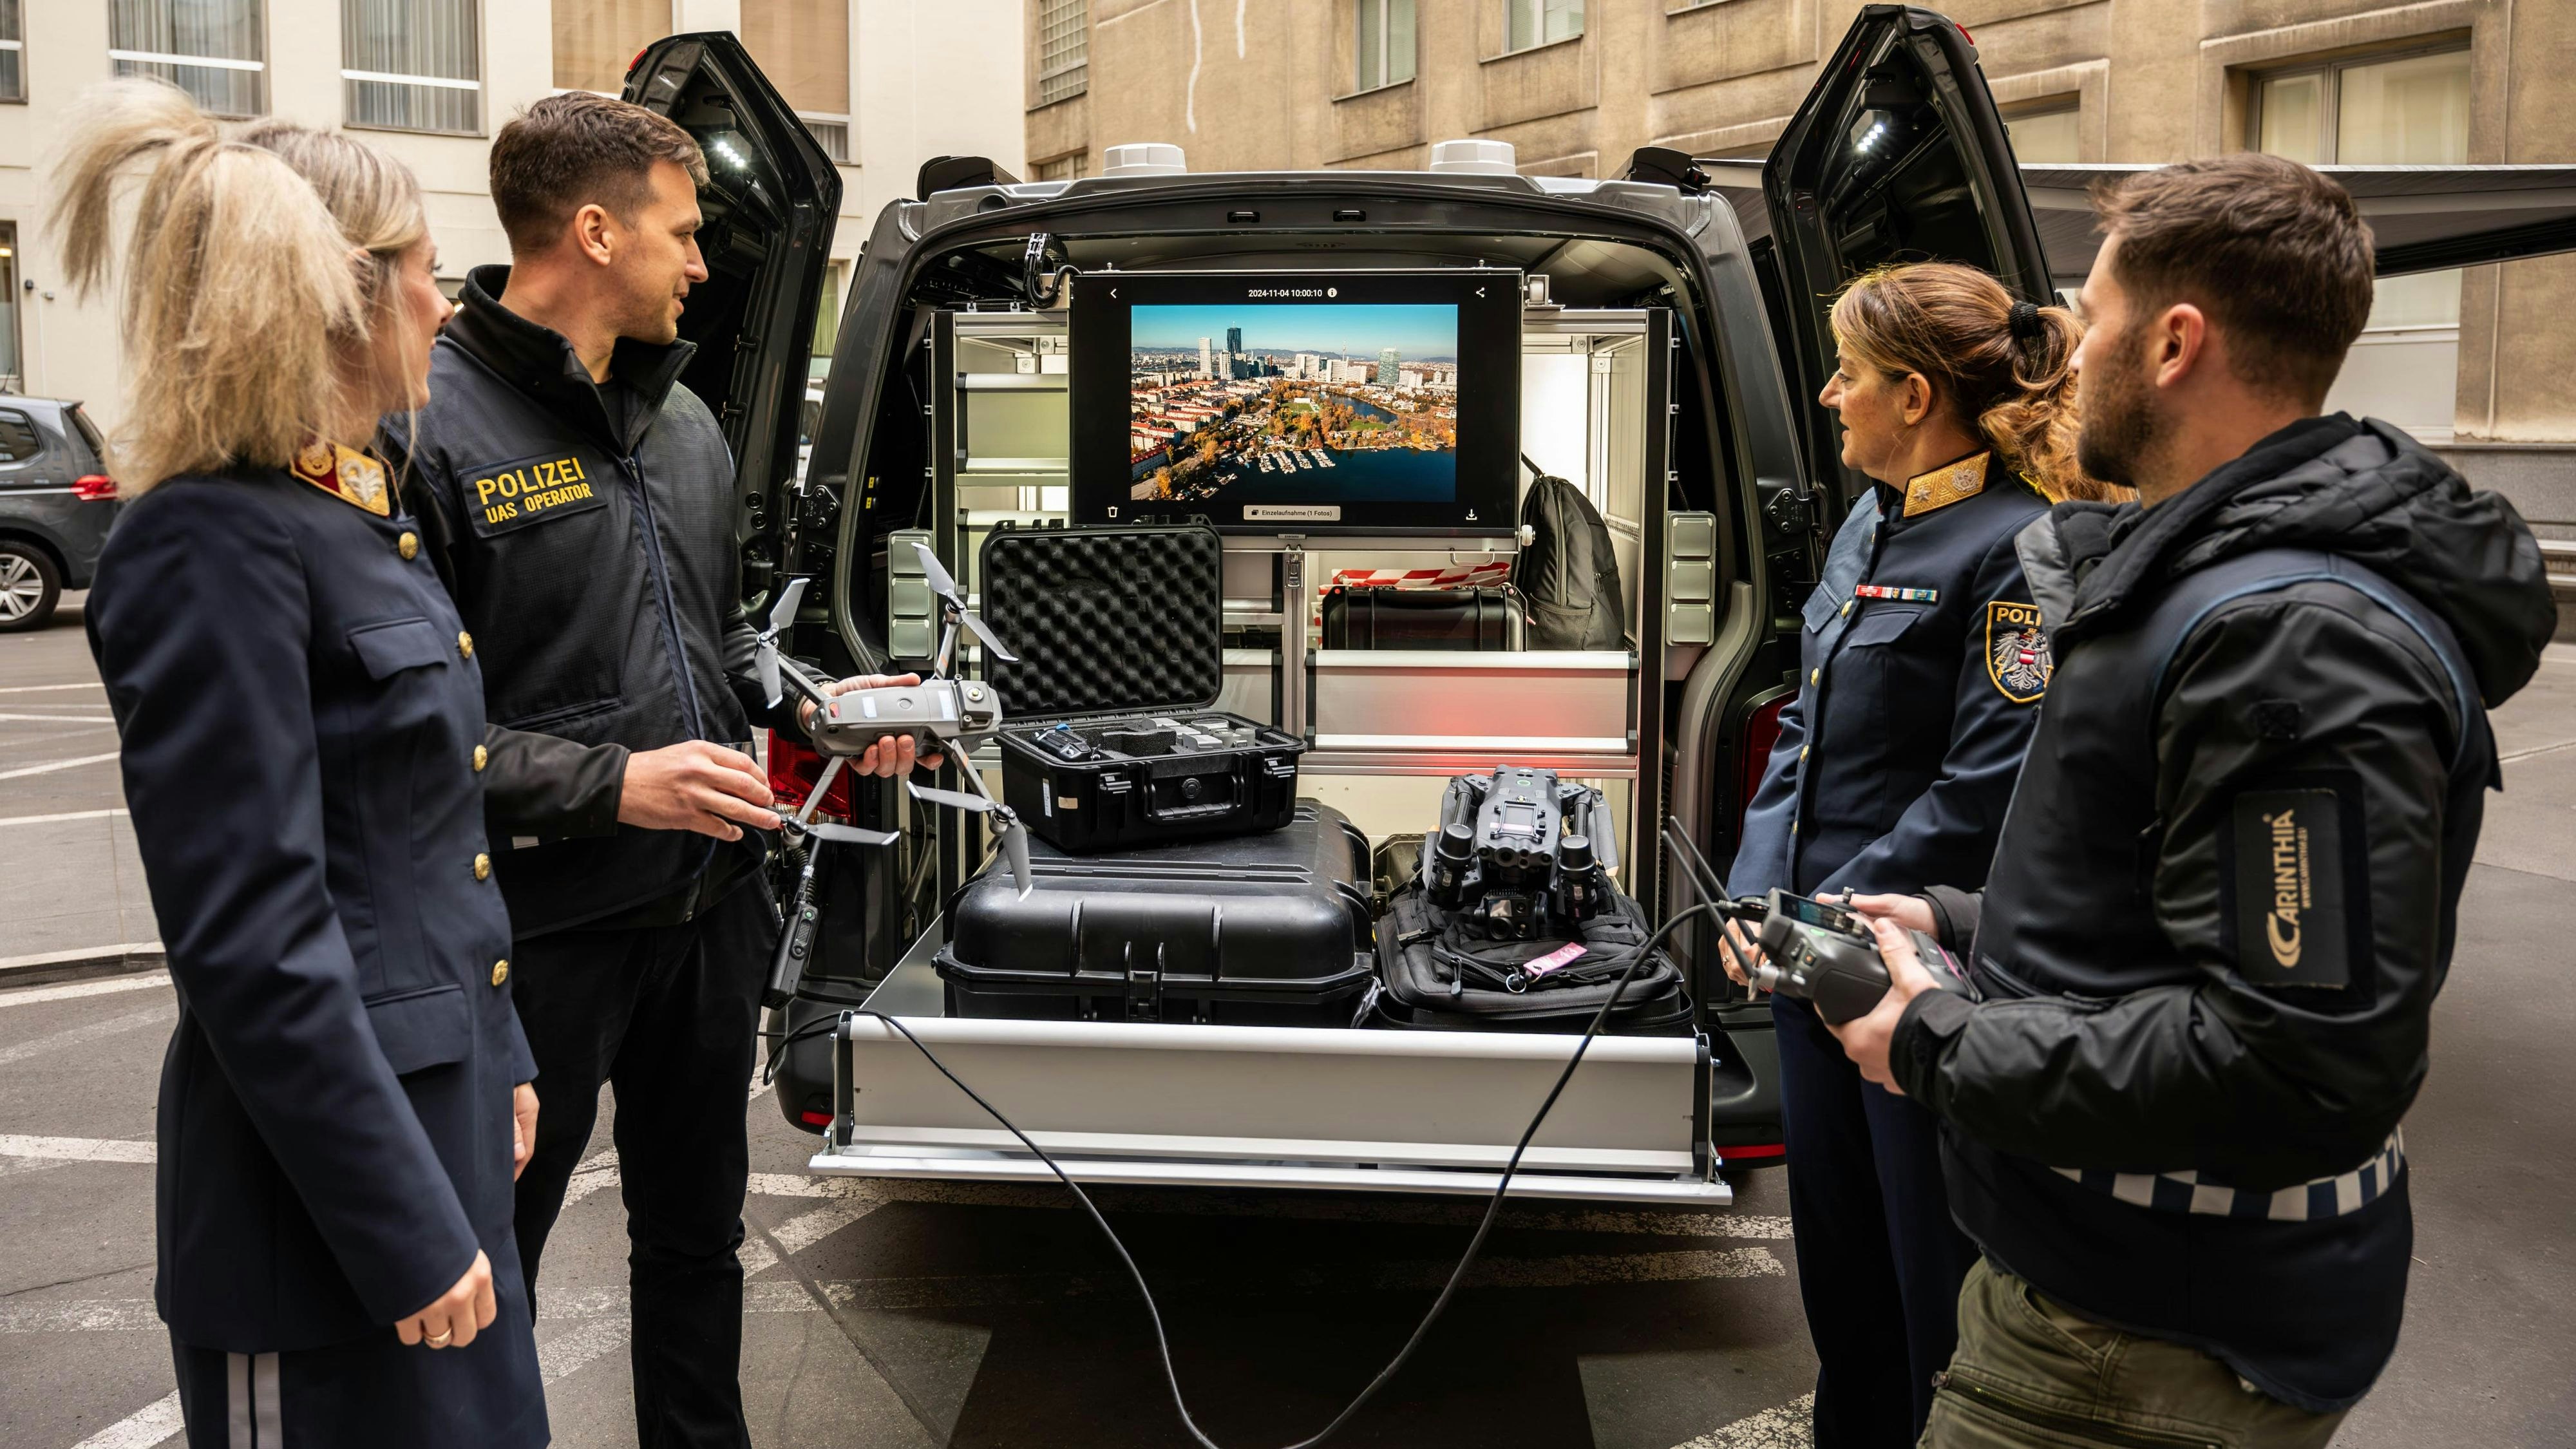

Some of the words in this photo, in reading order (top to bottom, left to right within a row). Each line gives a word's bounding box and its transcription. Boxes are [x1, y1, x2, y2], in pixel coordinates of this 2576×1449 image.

[475, 457, 585, 505] POLIZEI
[486, 502, 518, 524] UAS
[524, 483, 594, 512] OPERATOR
[1996, 607, 2042, 627] POLI
[2266, 809, 2302, 969] CARINTHIA
